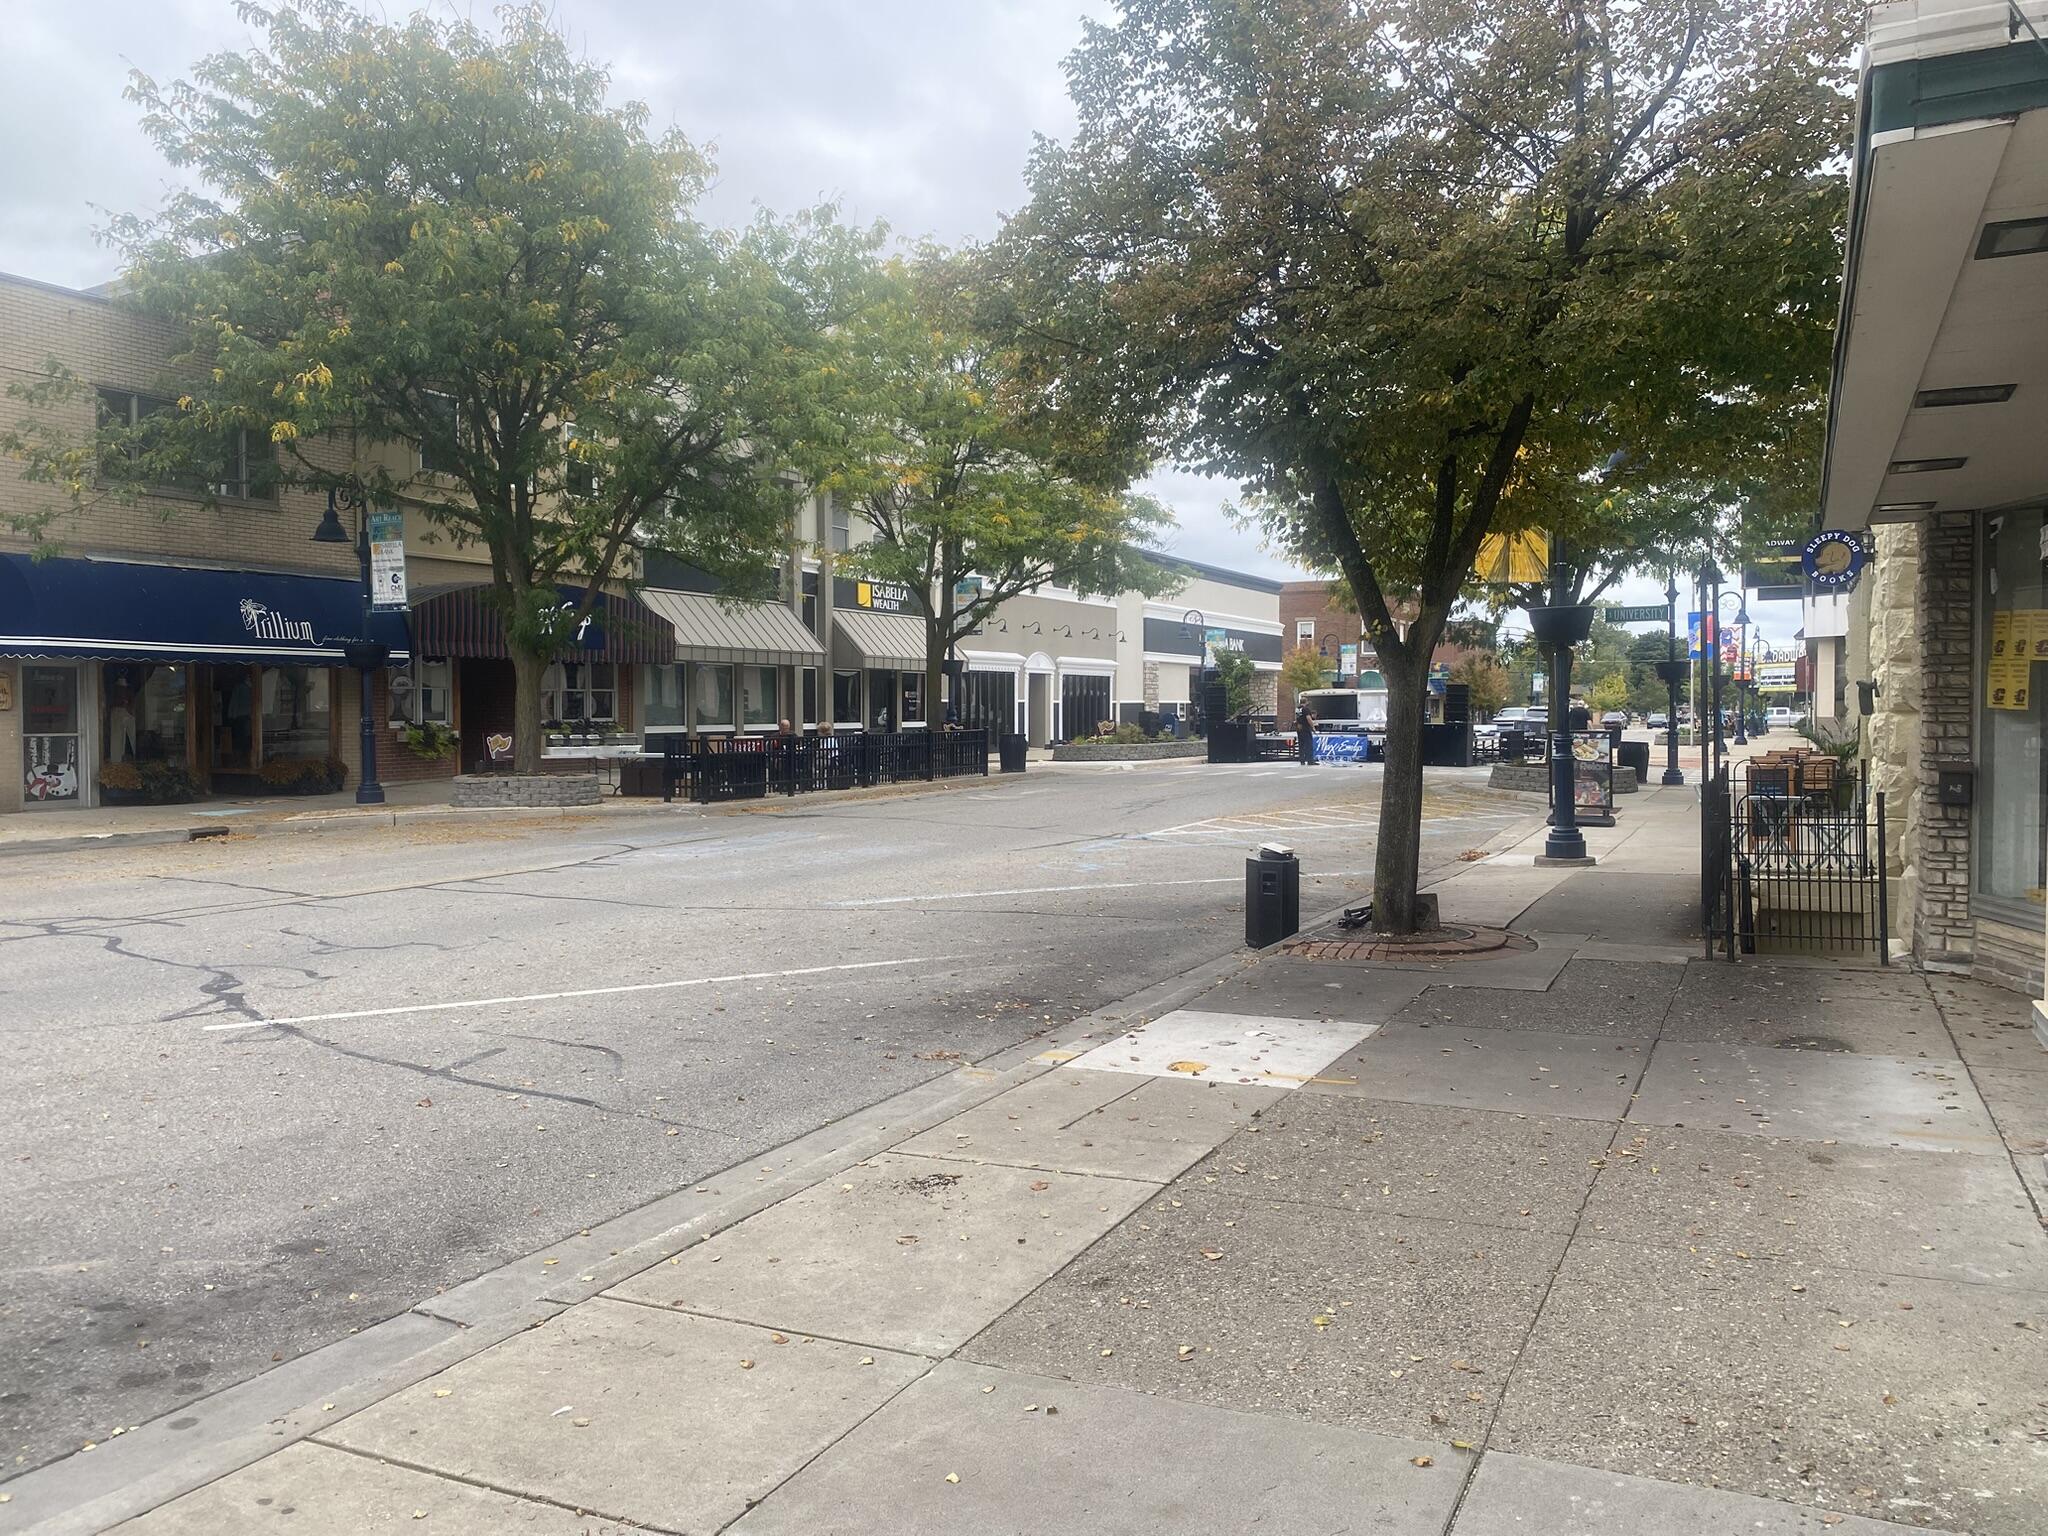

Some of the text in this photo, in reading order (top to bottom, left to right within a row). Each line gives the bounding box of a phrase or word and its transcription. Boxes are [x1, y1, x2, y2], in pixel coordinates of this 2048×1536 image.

[1806, 533, 1861, 553] SLEEPY DOG
[1812, 569, 1854, 584] BOOKS
[872, 584, 908, 602] ISABELLA
[872, 599, 900, 611] WEALTH
[1614, 607, 1665, 621] UNIVERSITY
[252, 609, 324, 646] Trillium
[1229, 637, 1246, 652] BANK
[1759, 649, 1807, 663] BOADWA
